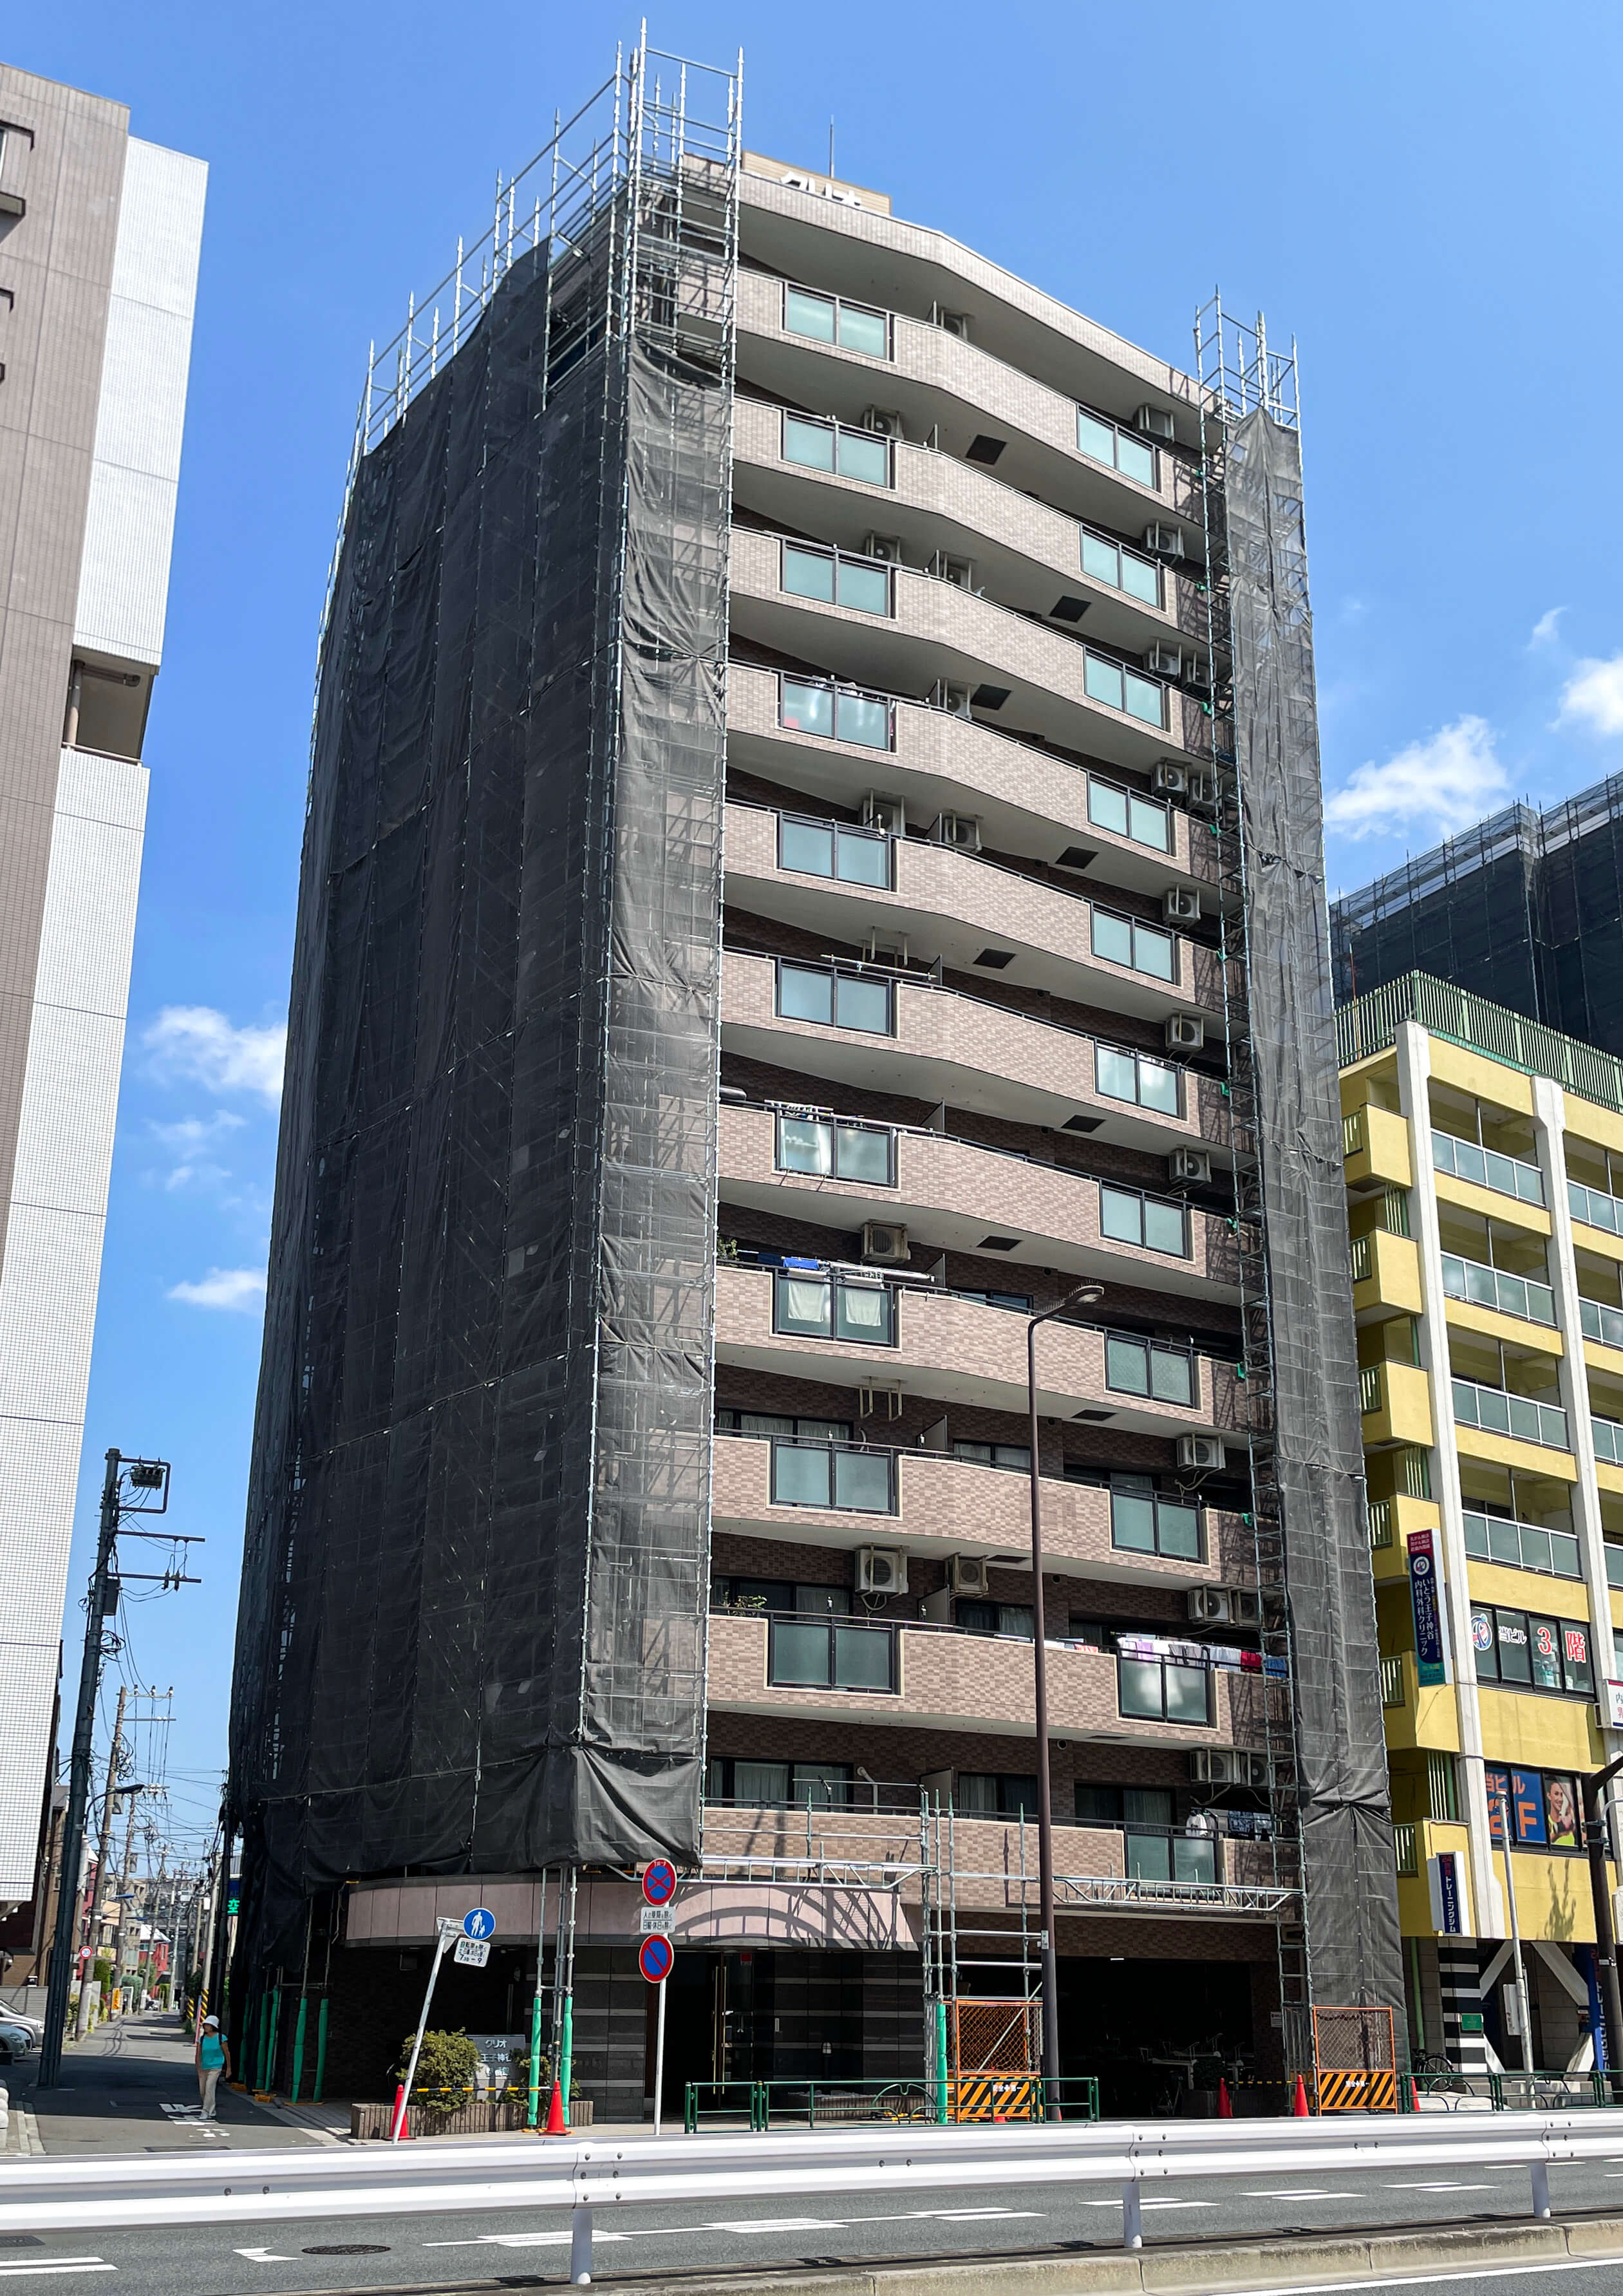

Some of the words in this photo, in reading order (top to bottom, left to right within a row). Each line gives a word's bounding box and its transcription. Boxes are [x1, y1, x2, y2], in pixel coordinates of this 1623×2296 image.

[1414, 1579, 1428, 1656] 内科外科クリニック
[1423, 1578, 1434, 1639] いとう王子神谷
[1499, 1626, 1528, 1645] 当ビル
[1486, 1773, 1526, 1794] 当ビル
[485, 2039, 508, 2048] クリオ
